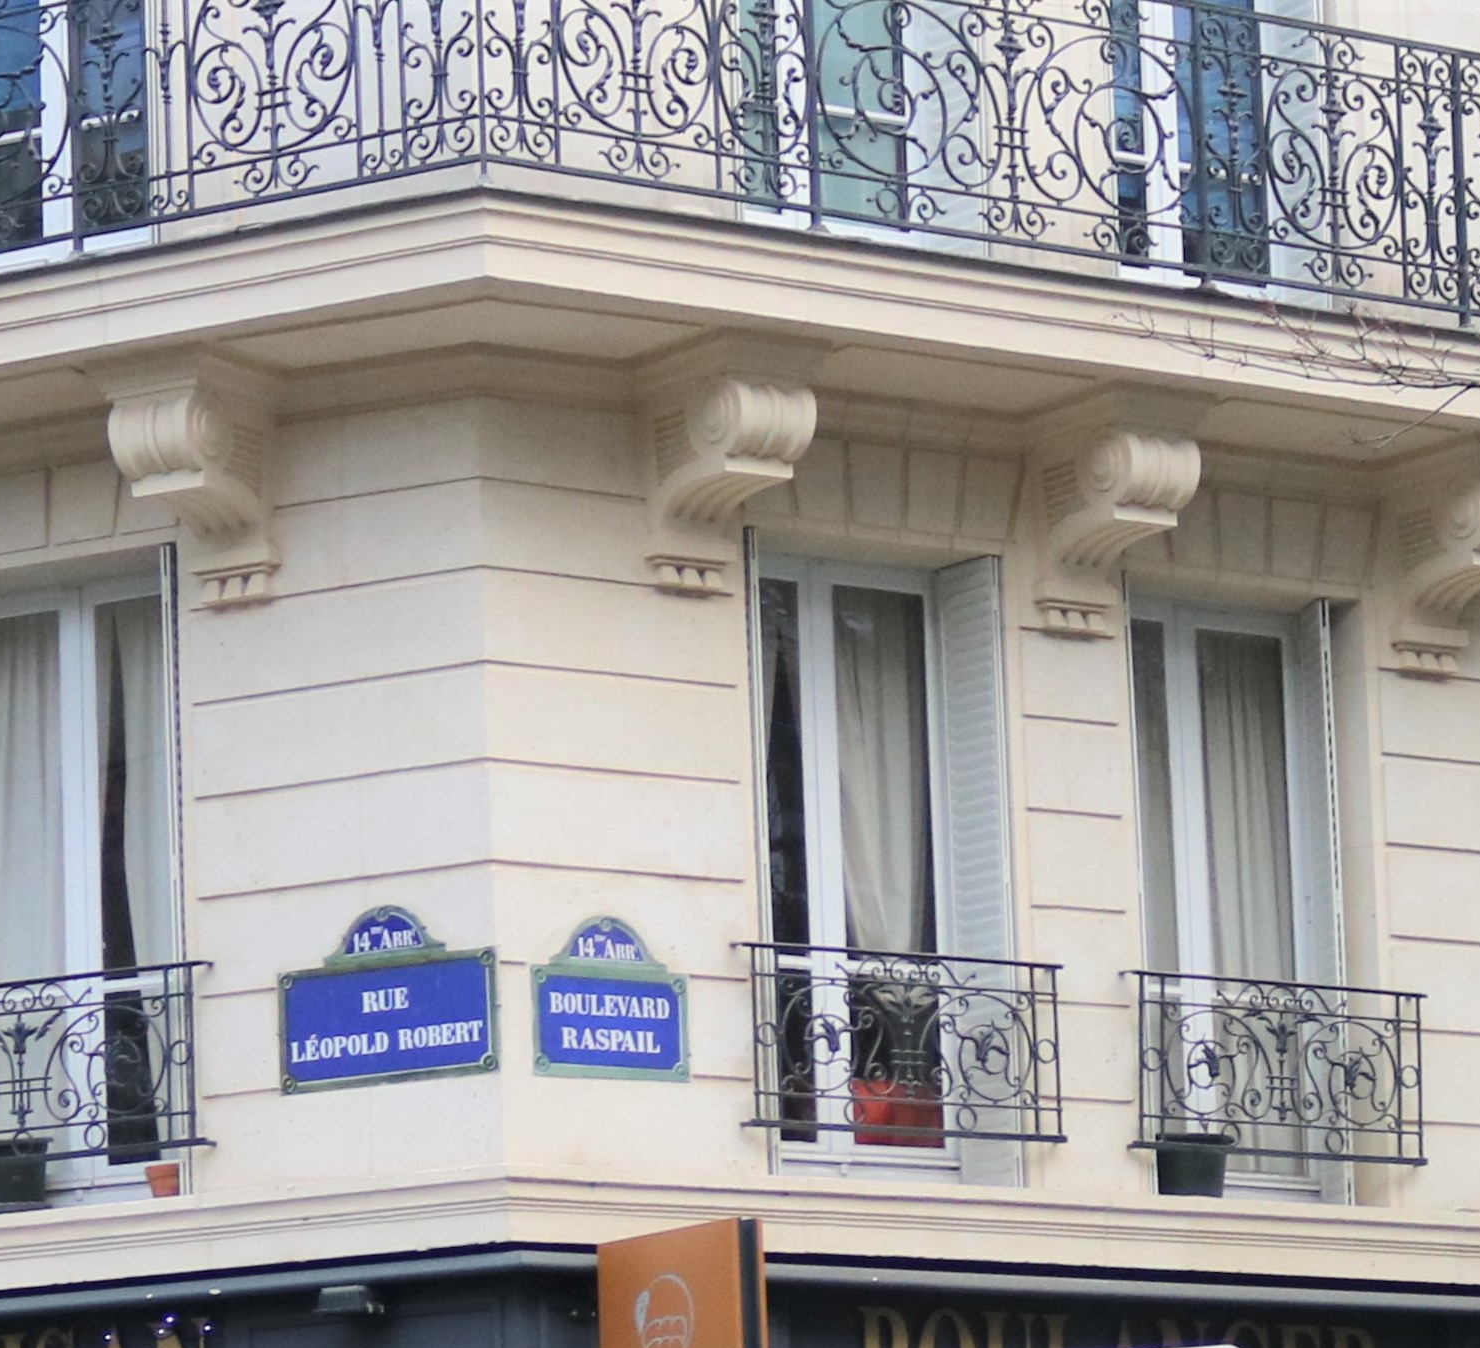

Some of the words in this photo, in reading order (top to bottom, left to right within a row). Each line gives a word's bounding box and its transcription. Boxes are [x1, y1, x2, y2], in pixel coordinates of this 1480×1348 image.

[362, 987, 409, 1014] RUE
[550, 992, 670, 1019] BOULEVARD
[291, 1030, 389, 1064] LÉOPOLD
[399, 1020, 483, 1052] ROBERT
[562, 1026, 661, 1054] RASPAIL
